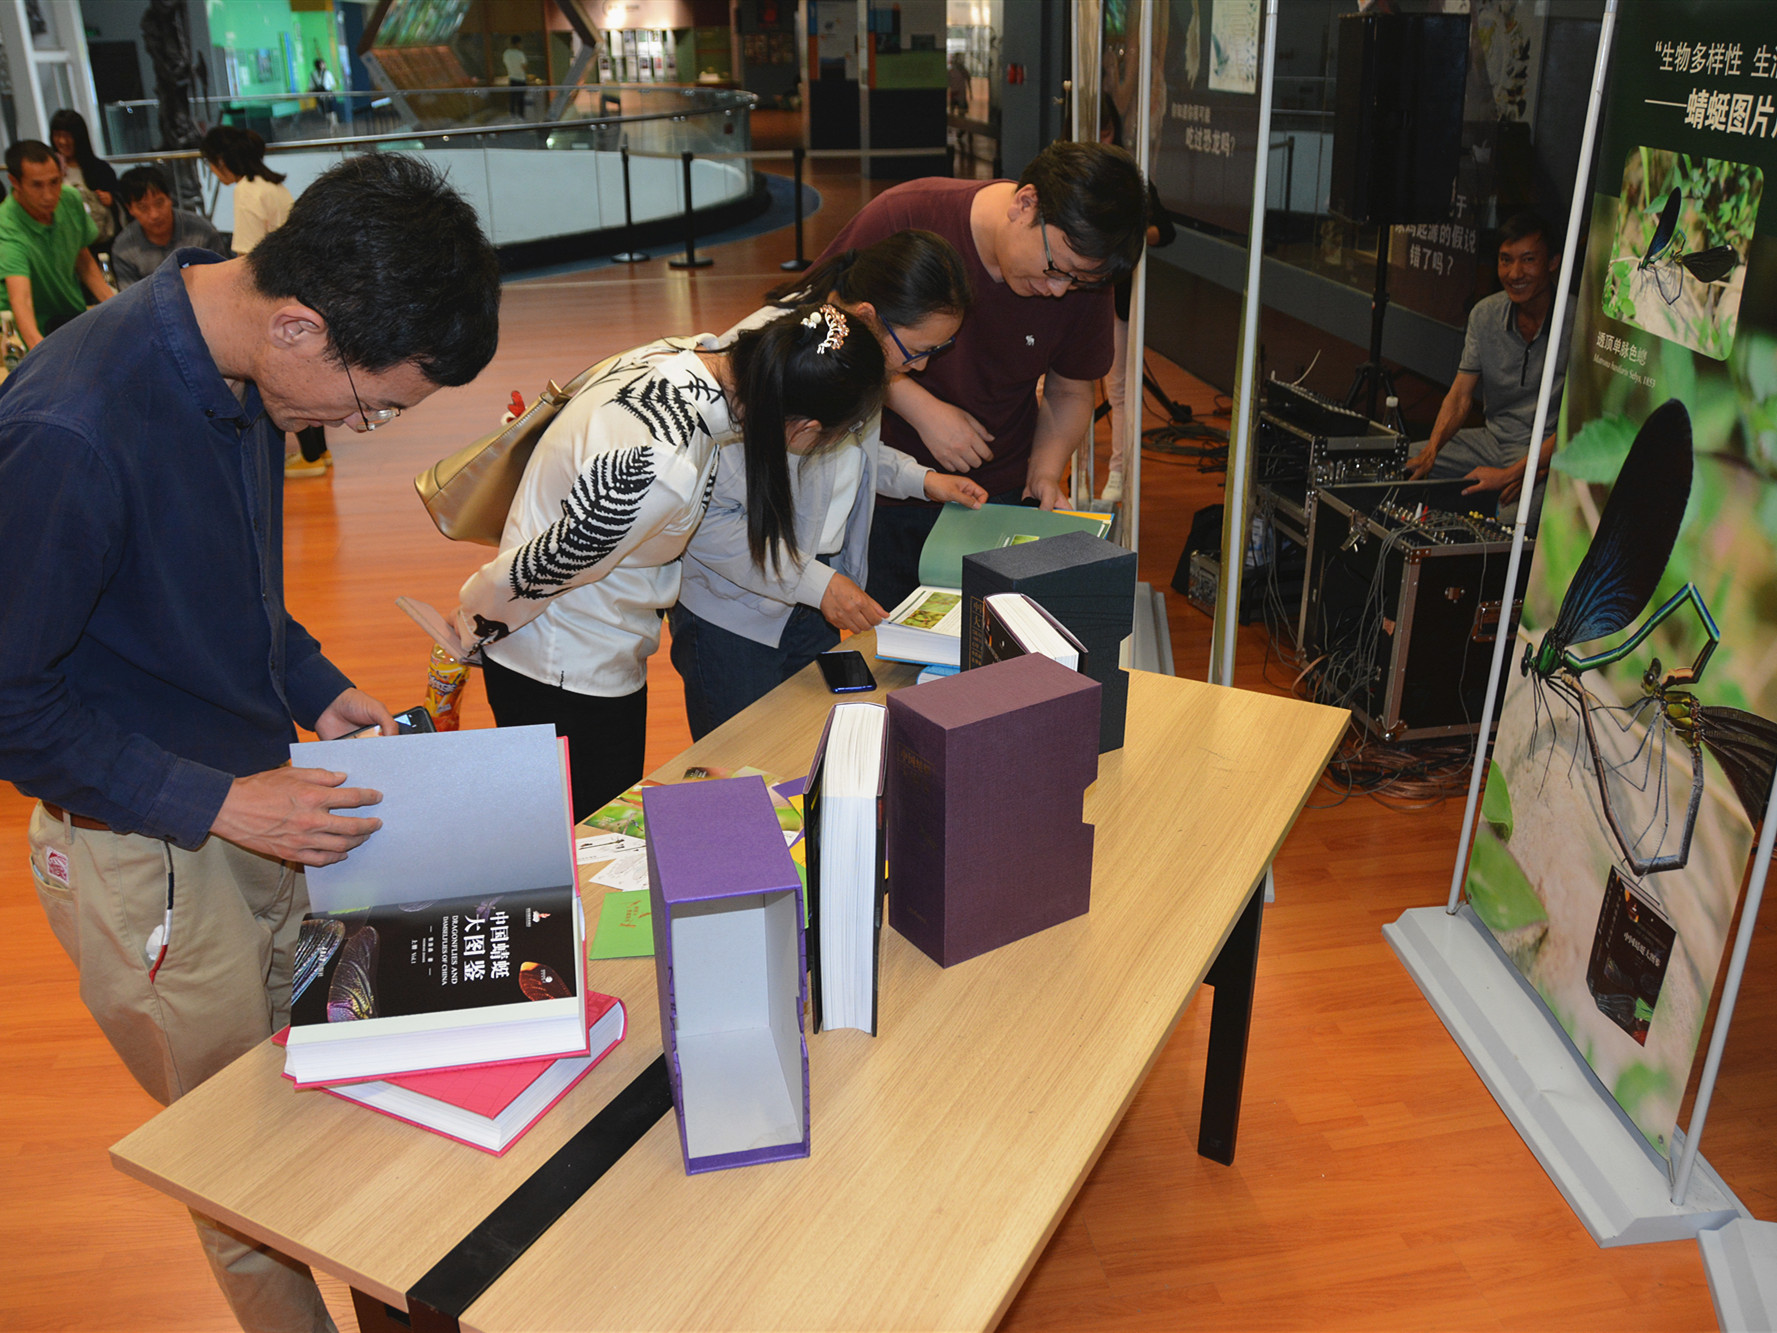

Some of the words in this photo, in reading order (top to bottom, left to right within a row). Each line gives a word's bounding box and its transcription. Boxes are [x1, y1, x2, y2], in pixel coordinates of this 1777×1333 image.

[1655, 41, 1743, 76] “生物多样性
[1644, 88, 1777, 139] ——蜻蜓图片
[441, 955, 448, 964] OF
[451, 915, 459, 966] DRAGONFLIES
[463, 913, 486, 982] 大图鉴
[489, 911, 510, 979] 中国蜻蜓
[450, 967, 458, 985] AND
